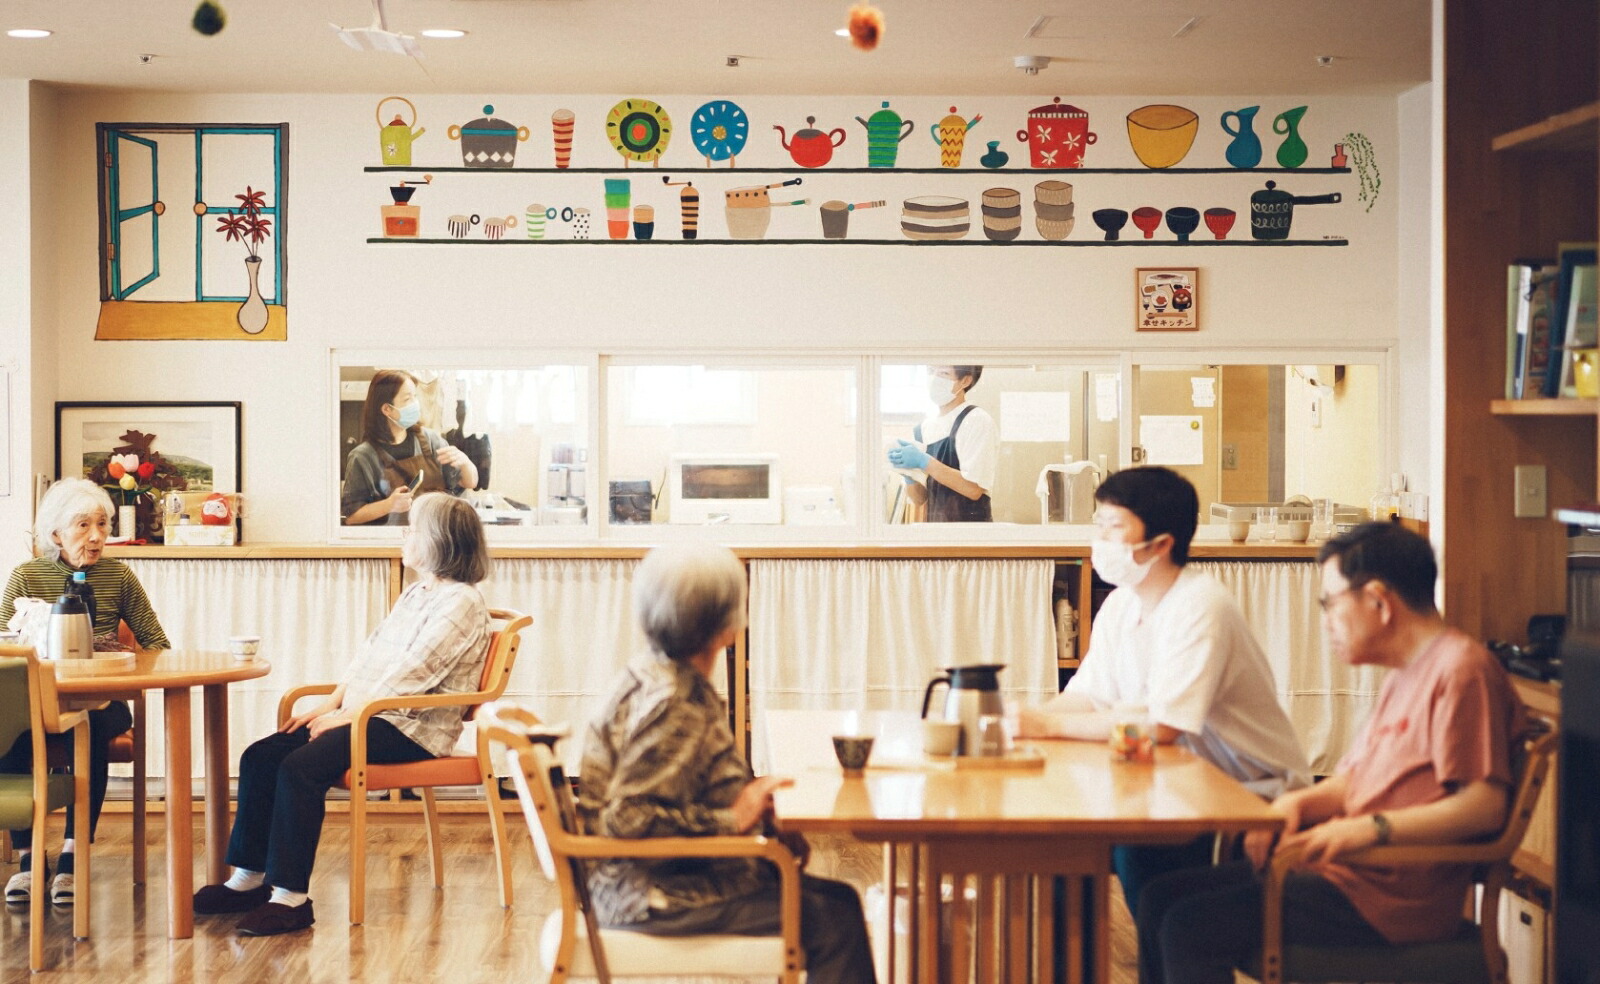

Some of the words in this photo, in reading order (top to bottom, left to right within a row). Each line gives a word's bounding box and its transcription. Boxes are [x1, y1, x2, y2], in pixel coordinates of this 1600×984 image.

[1142, 319, 1192, 327] 幸せキッチン
